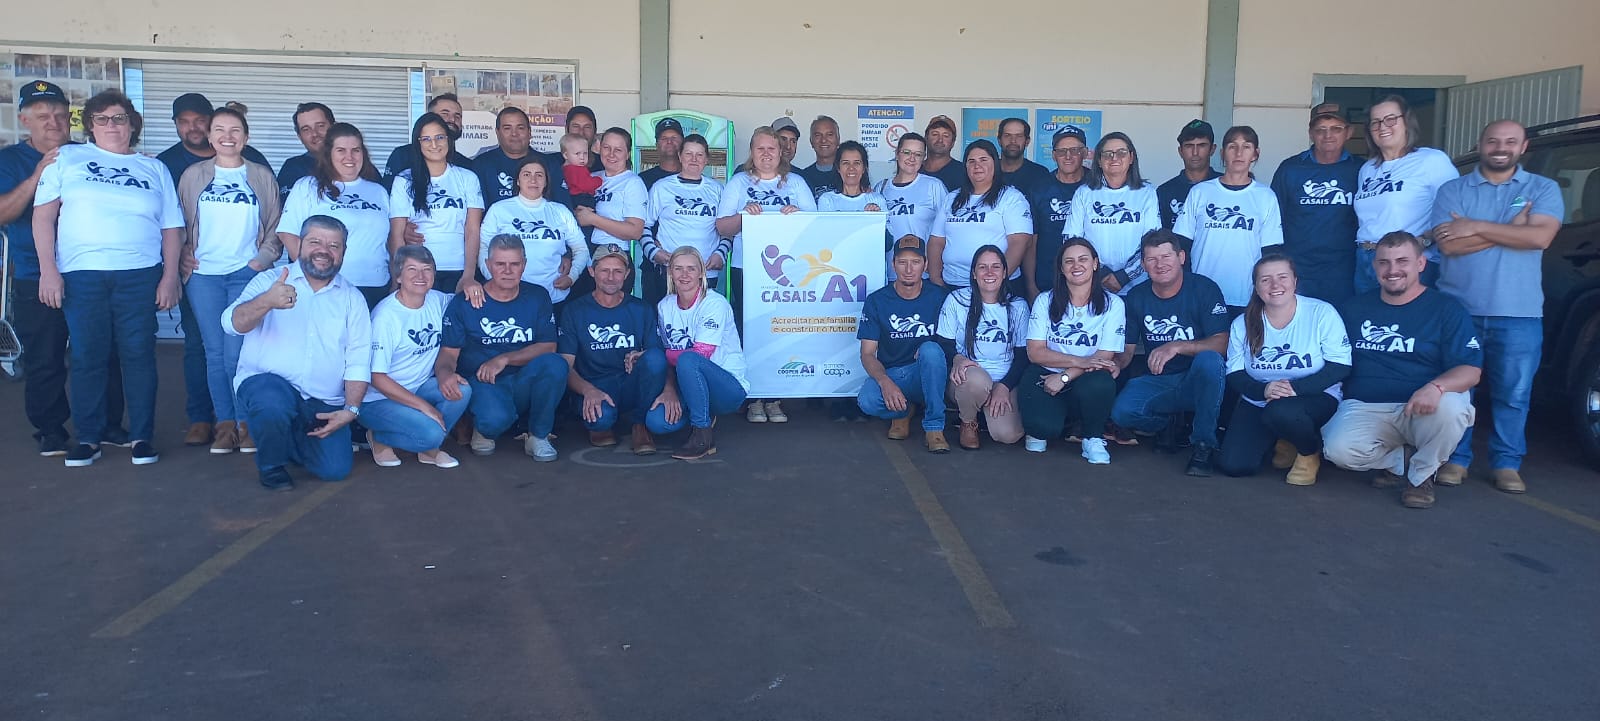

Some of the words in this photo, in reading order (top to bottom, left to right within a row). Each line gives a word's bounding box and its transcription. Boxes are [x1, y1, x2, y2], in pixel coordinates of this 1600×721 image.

[528, 115, 554, 125] NÇÃO!
[868, 109, 905, 118] ATENÇÃO!
[1051, 115, 1091, 124] SORTEIO
[86, 176, 121, 186] CASAIS
[123, 177, 150, 190] A1
[1378, 180, 1404, 195] A1
[200, 195, 231, 203] CASAIS
[232, 192, 257, 206] A1
[499, 189, 513, 197] CAS
[1330, 191, 1353, 205] A1
[443, 197, 464, 210] A1
[771, 196, 791, 206] A1
[675, 208, 698, 216] CASAIS
[699, 205, 717, 217] A1
[897, 203, 915, 216] A1
[965, 211, 986, 223] A1
[1091, 217, 1117, 225] CASAIS
[1118, 211, 1141, 224] A1
[1204, 222, 1230, 230] CASAIS
[1231, 216, 1255, 231] A1
[541, 228, 561, 241] A1
[761, 290, 817, 303] CASAIS
[820, 274, 867, 303] A1
[781, 325, 820, 333] construir
[829, 325, 857, 333] futuro
[890, 332, 914, 340] CASAIS
[914, 323, 935, 338] A1
[1147, 334, 1173, 342] CASAIS
[1173, 326, 1195, 341] A1
[482, 337, 510, 346] CASAIS
[510, 327, 533, 344] A1
[590, 342, 614, 351] CASAIS
[614, 334, 635, 349] A1
[1048, 335, 1073, 346] CASAIS
[1074, 333, 1099, 347] A1
[1355, 341, 1387, 352] CASAIS
[1387, 337, 1416, 353] A1
[799, 364, 815, 374] A1
[1250, 363, 1282, 371] CASAIS
[1284, 353, 1313, 370] A1
